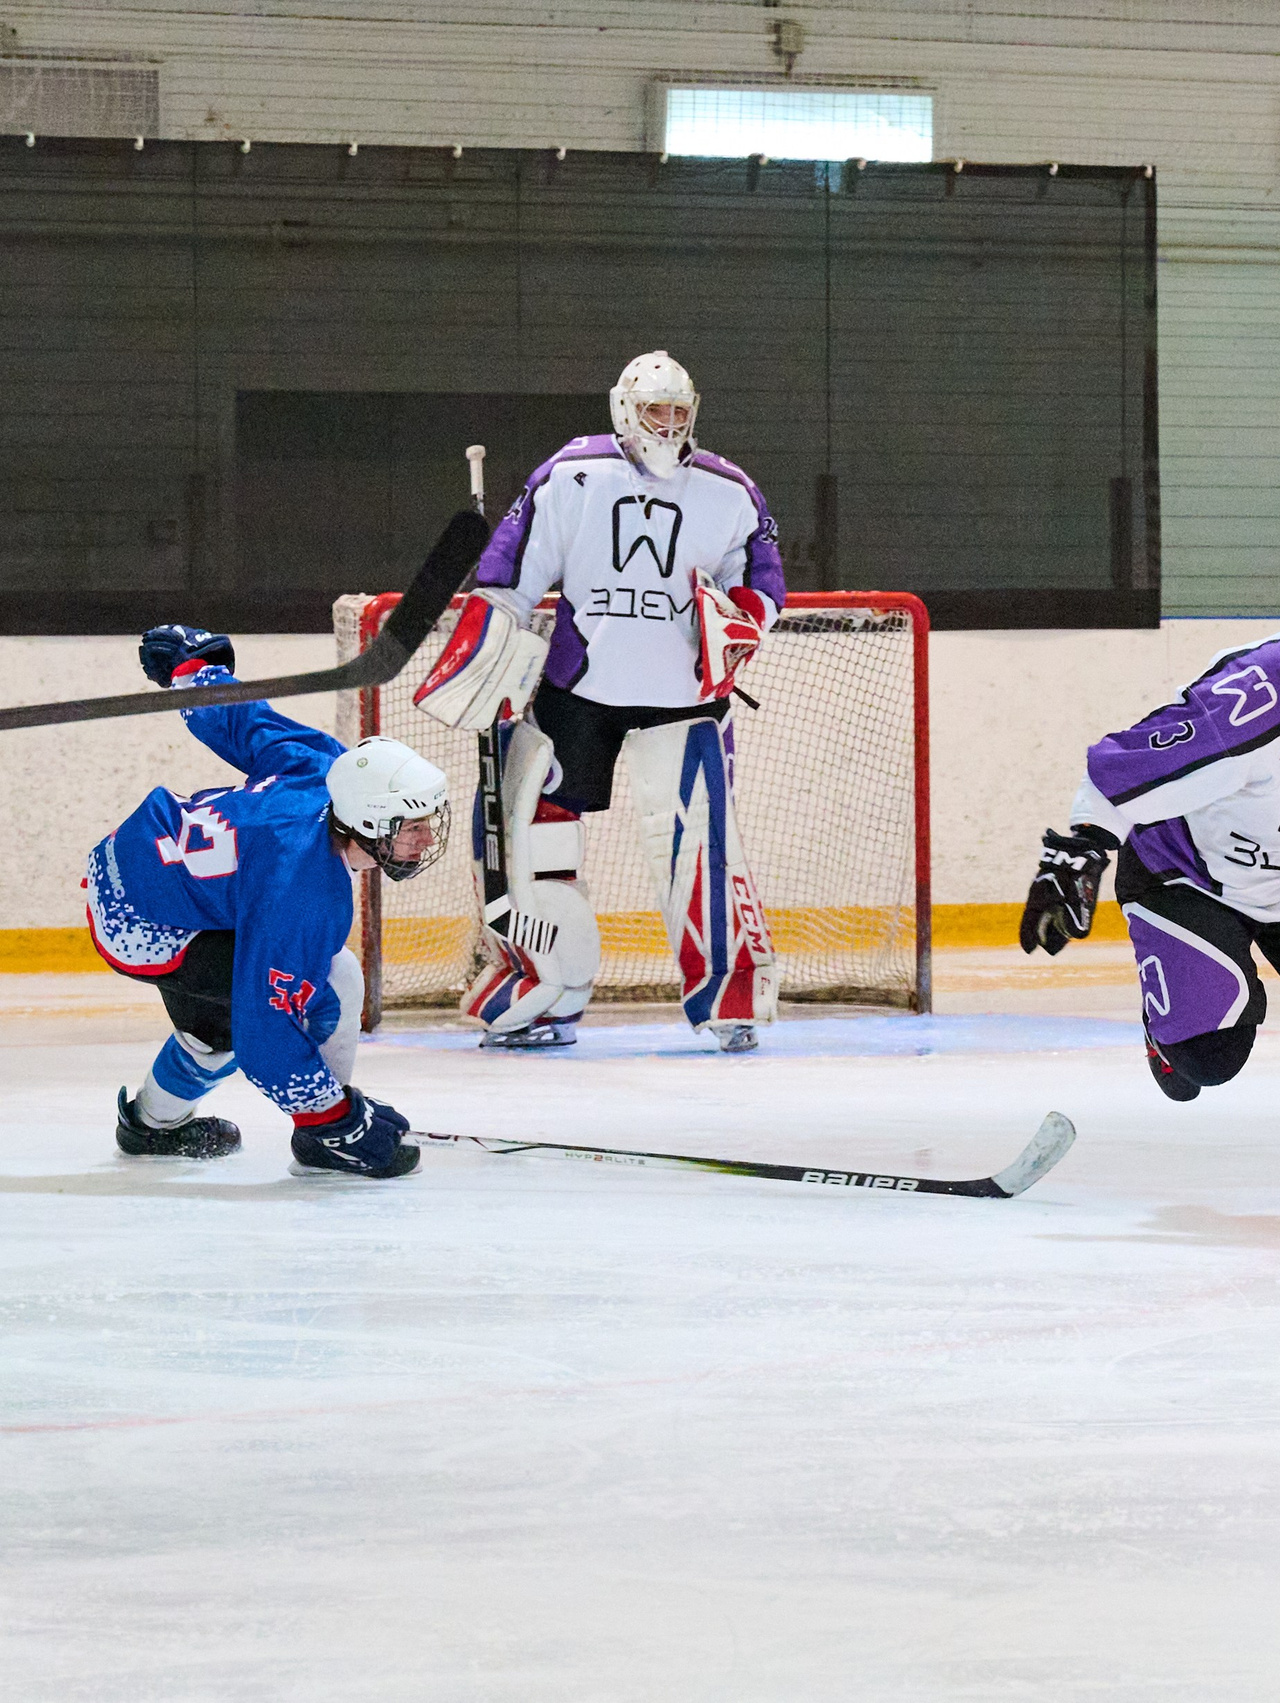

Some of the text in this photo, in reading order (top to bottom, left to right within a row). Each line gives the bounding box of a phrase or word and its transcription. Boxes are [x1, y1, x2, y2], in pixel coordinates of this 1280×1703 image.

[425, 639, 470, 689] CCM
[1148, 719, 1197, 751] 3
[1039, 847, 1089, 871] CM
[732, 875, 767, 954] CCM
[322, 1106, 375, 1148] CCM
[801, 1170, 920, 1192] BAUER
